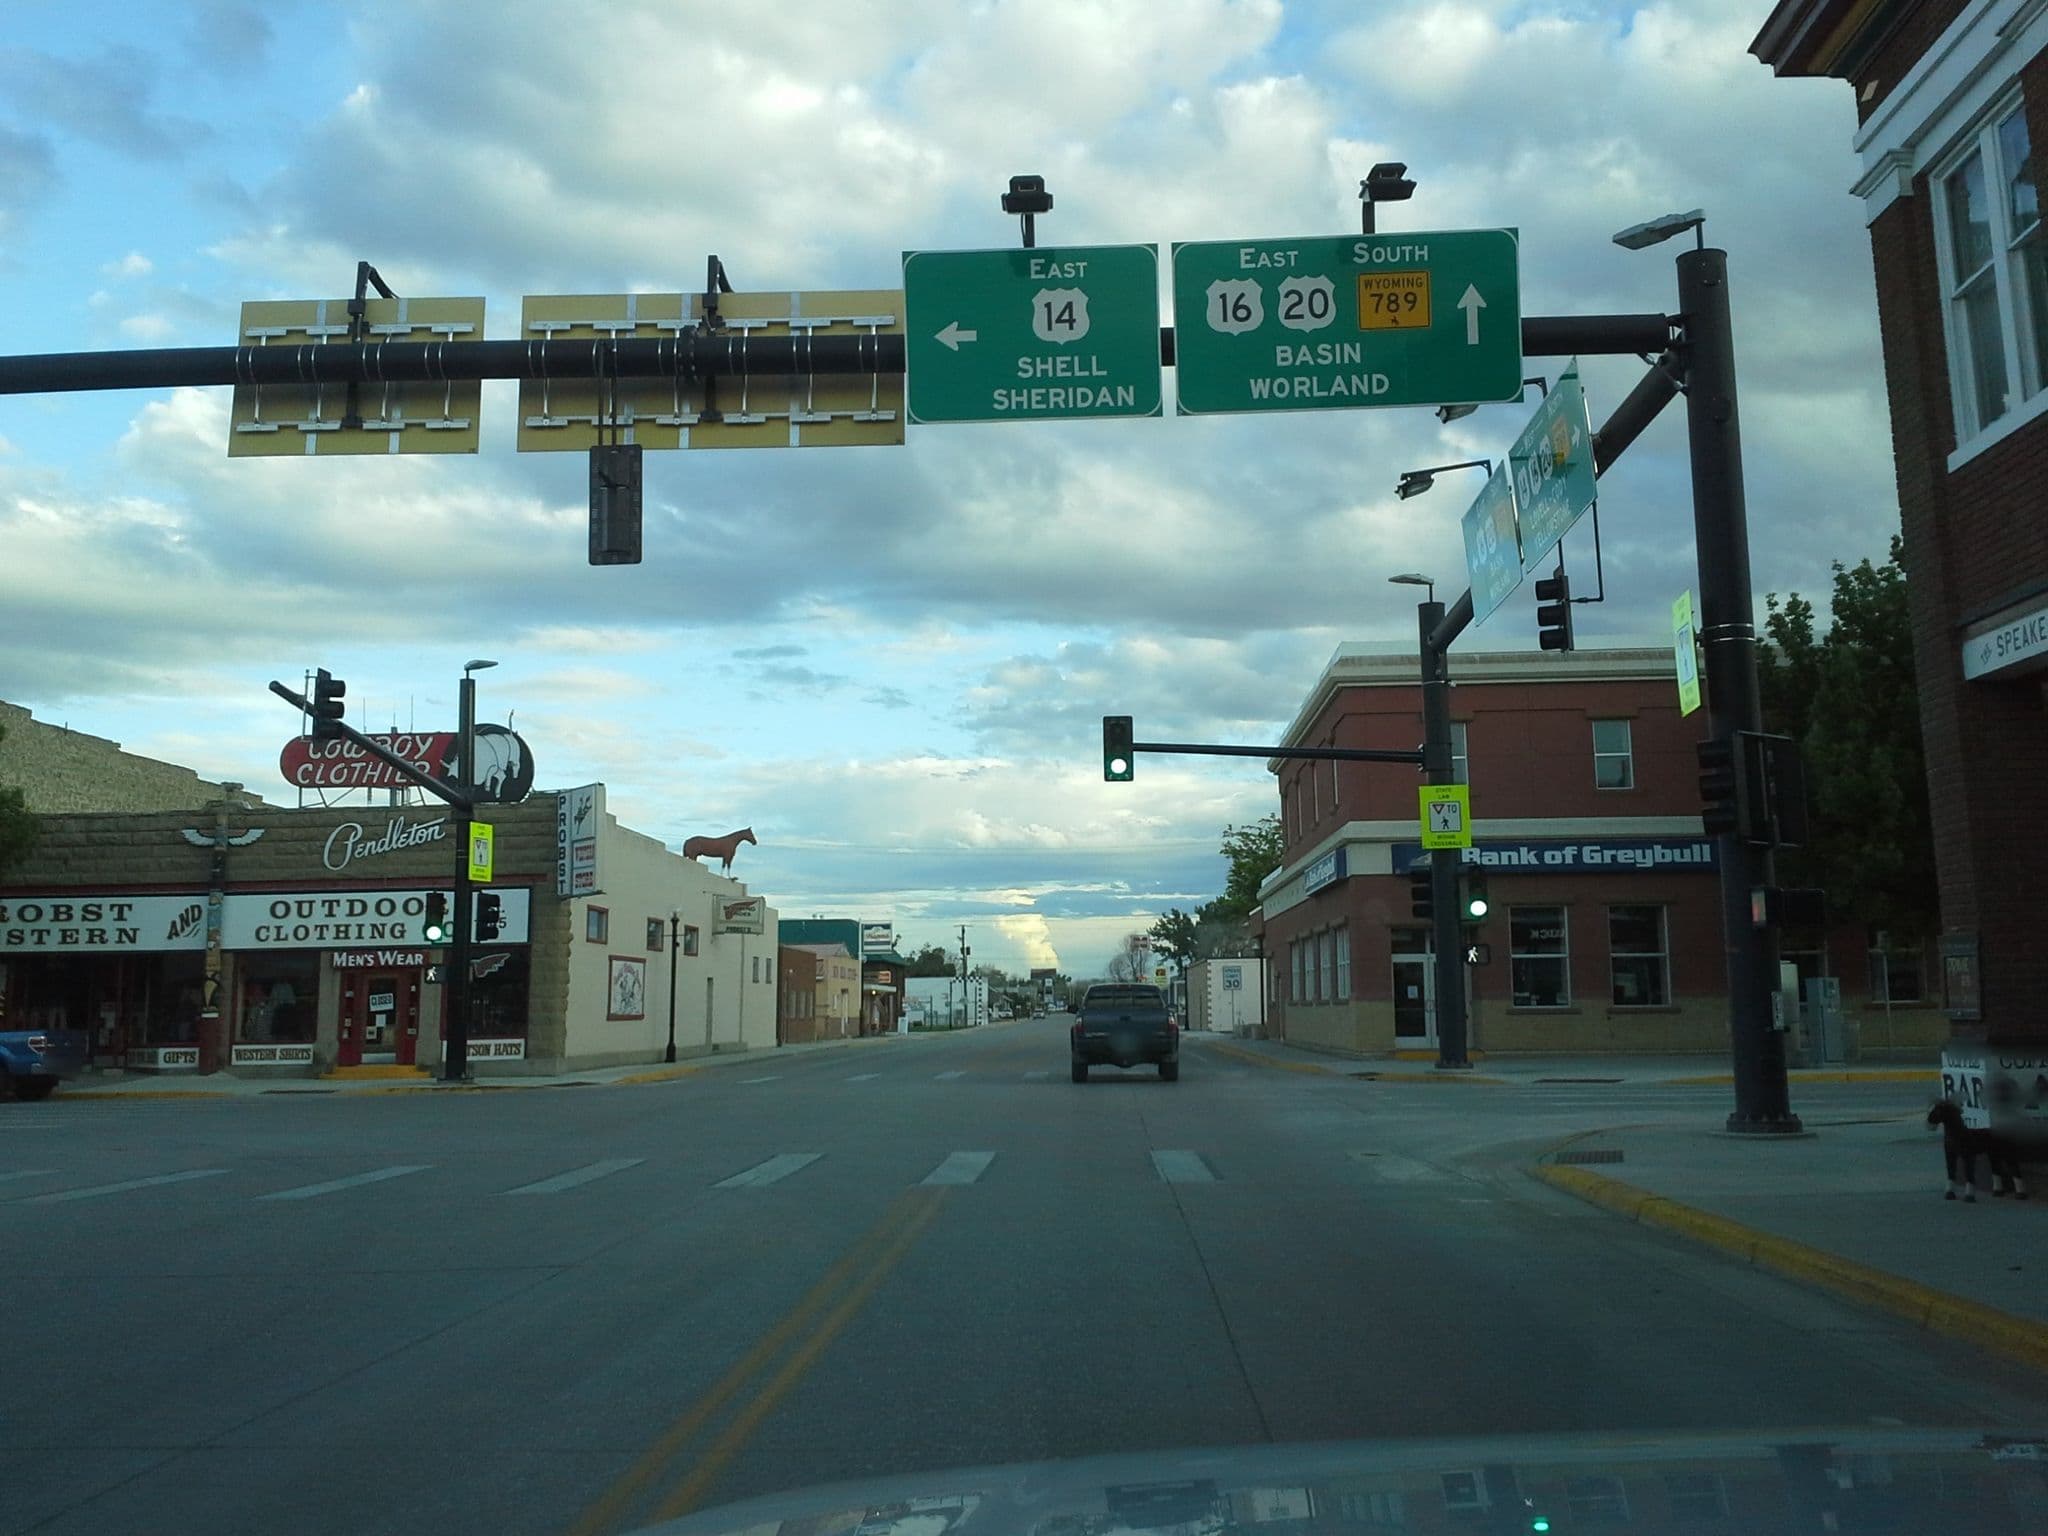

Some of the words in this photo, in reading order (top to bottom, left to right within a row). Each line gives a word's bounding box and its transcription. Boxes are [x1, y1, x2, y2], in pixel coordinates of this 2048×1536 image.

[1240, 248, 1299, 270] EAST
[1352, 242, 1430, 264] SOUTH
[1029, 258, 1087, 281] EAST
[1362, 275, 1424, 291] WYOMING
[1219, 291, 1253, 323] 16
[1283, 288, 1330, 320] 20
[1369, 291, 1418, 316] 789
[1043, 300, 1077, 332] 14
[1275, 342, 1362, 367] BASIN
[1016, 355, 1108, 379] SHELL
[991, 385, 1136, 412] SHERIDAN
[1249, 374, 1390, 399] WORLAND
[1447, 804, 1458, 813] TO
[323, 815, 446, 871] Pendleton
[558, 795, 567, 894] PROBST
[1462, 847, 1540, 866] Bank
[1545, 845, 1577, 866] of
[1582, 843, 1712, 868] Greybull
[269, 897, 450, 920] OUTDOO
[167, 904, 202, 940] AND
[255, 922, 407, 943] CLOTHING
[333, 951, 374, 967] MEN'S
[377, 950, 423, 966] WEAR
[1225, 979, 1240, 988] 30
[163, 1051, 196, 1064] GIFTS
[494, 1043, 521, 1056] HATS
